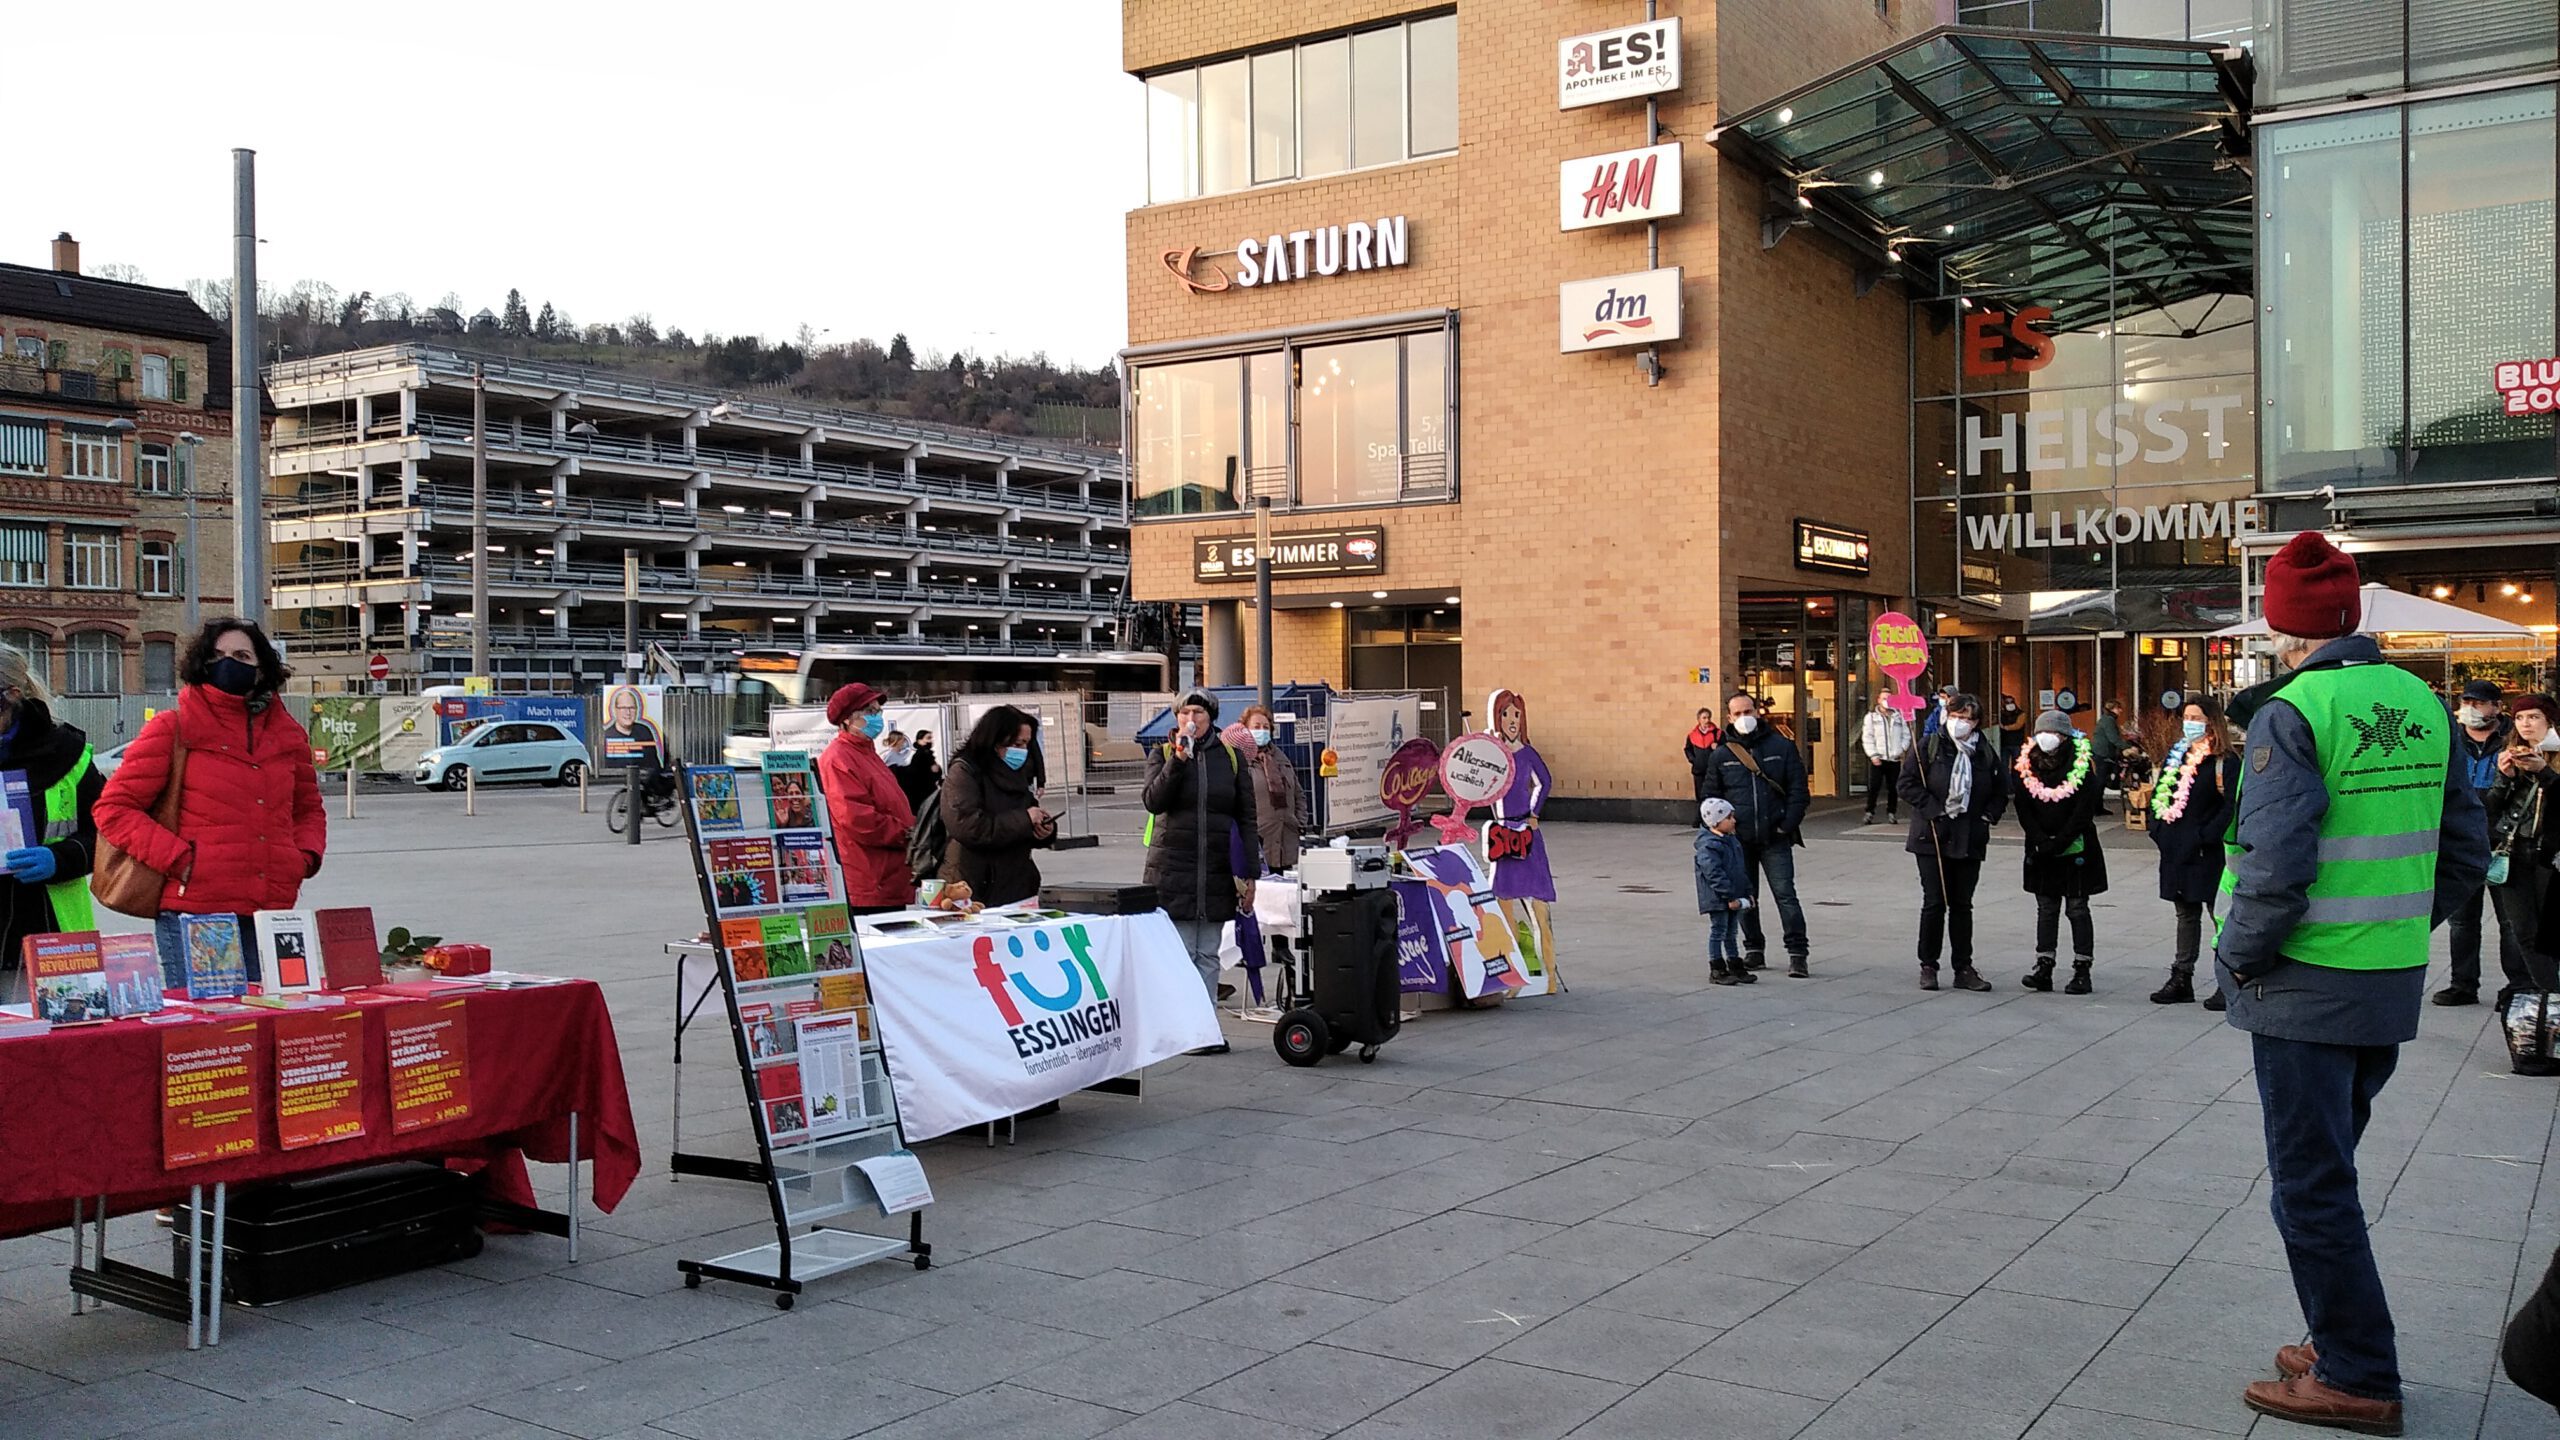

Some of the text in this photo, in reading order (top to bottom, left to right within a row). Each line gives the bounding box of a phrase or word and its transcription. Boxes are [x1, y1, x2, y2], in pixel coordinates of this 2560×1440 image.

[1565, 72, 1626, 90] APOTHEKE
[1631, 69, 1643, 78] IM
[1582, 154, 1658, 219] H&M
[1237, 215, 1408, 287] SATURN
[1595, 288, 1647, 322] dm
[1964, 306, 2055, 376] ES
[1965, 394, 2242, 476] HEISST
[1231, 542, 1339, 567] ESZIMMER
[527, 706, 576, 716] Mach mehr
[321, 717, 357, 733] Platz
[333, 733, 354, 746] da!
[1453, 747, 1507, 775] Altersarmut
[1470, 767, 1479, 776] ist
[1489, 825, 1532, 860] STOP
[813, 914, 848, 935] ALARM!
[39, 956, 98, 973] REVOLUTION
[973, 924, 1109, 1027] für
[1006, 998, 1121, 1059] ESSLINGEN
[167, 1043, 253, 1063] Coronakrise ist auch
[392, 1050, 442, 1068] MONOPOLE
[1024, 1050, 1070, 1077] fortschrittlich
[167, 1055, 242, 1074] Kapitalismuskrise
[405, 1063, 439, 1078] LASTEN
[167, 1065, 249, 1086] ALTERNATIVE:
[167, 1081, 213, 1096] ECHTER
[167, 1086, 250, 1107] SOZIALISMUS!
[409, 1081, 446, 1098] MASSEN
